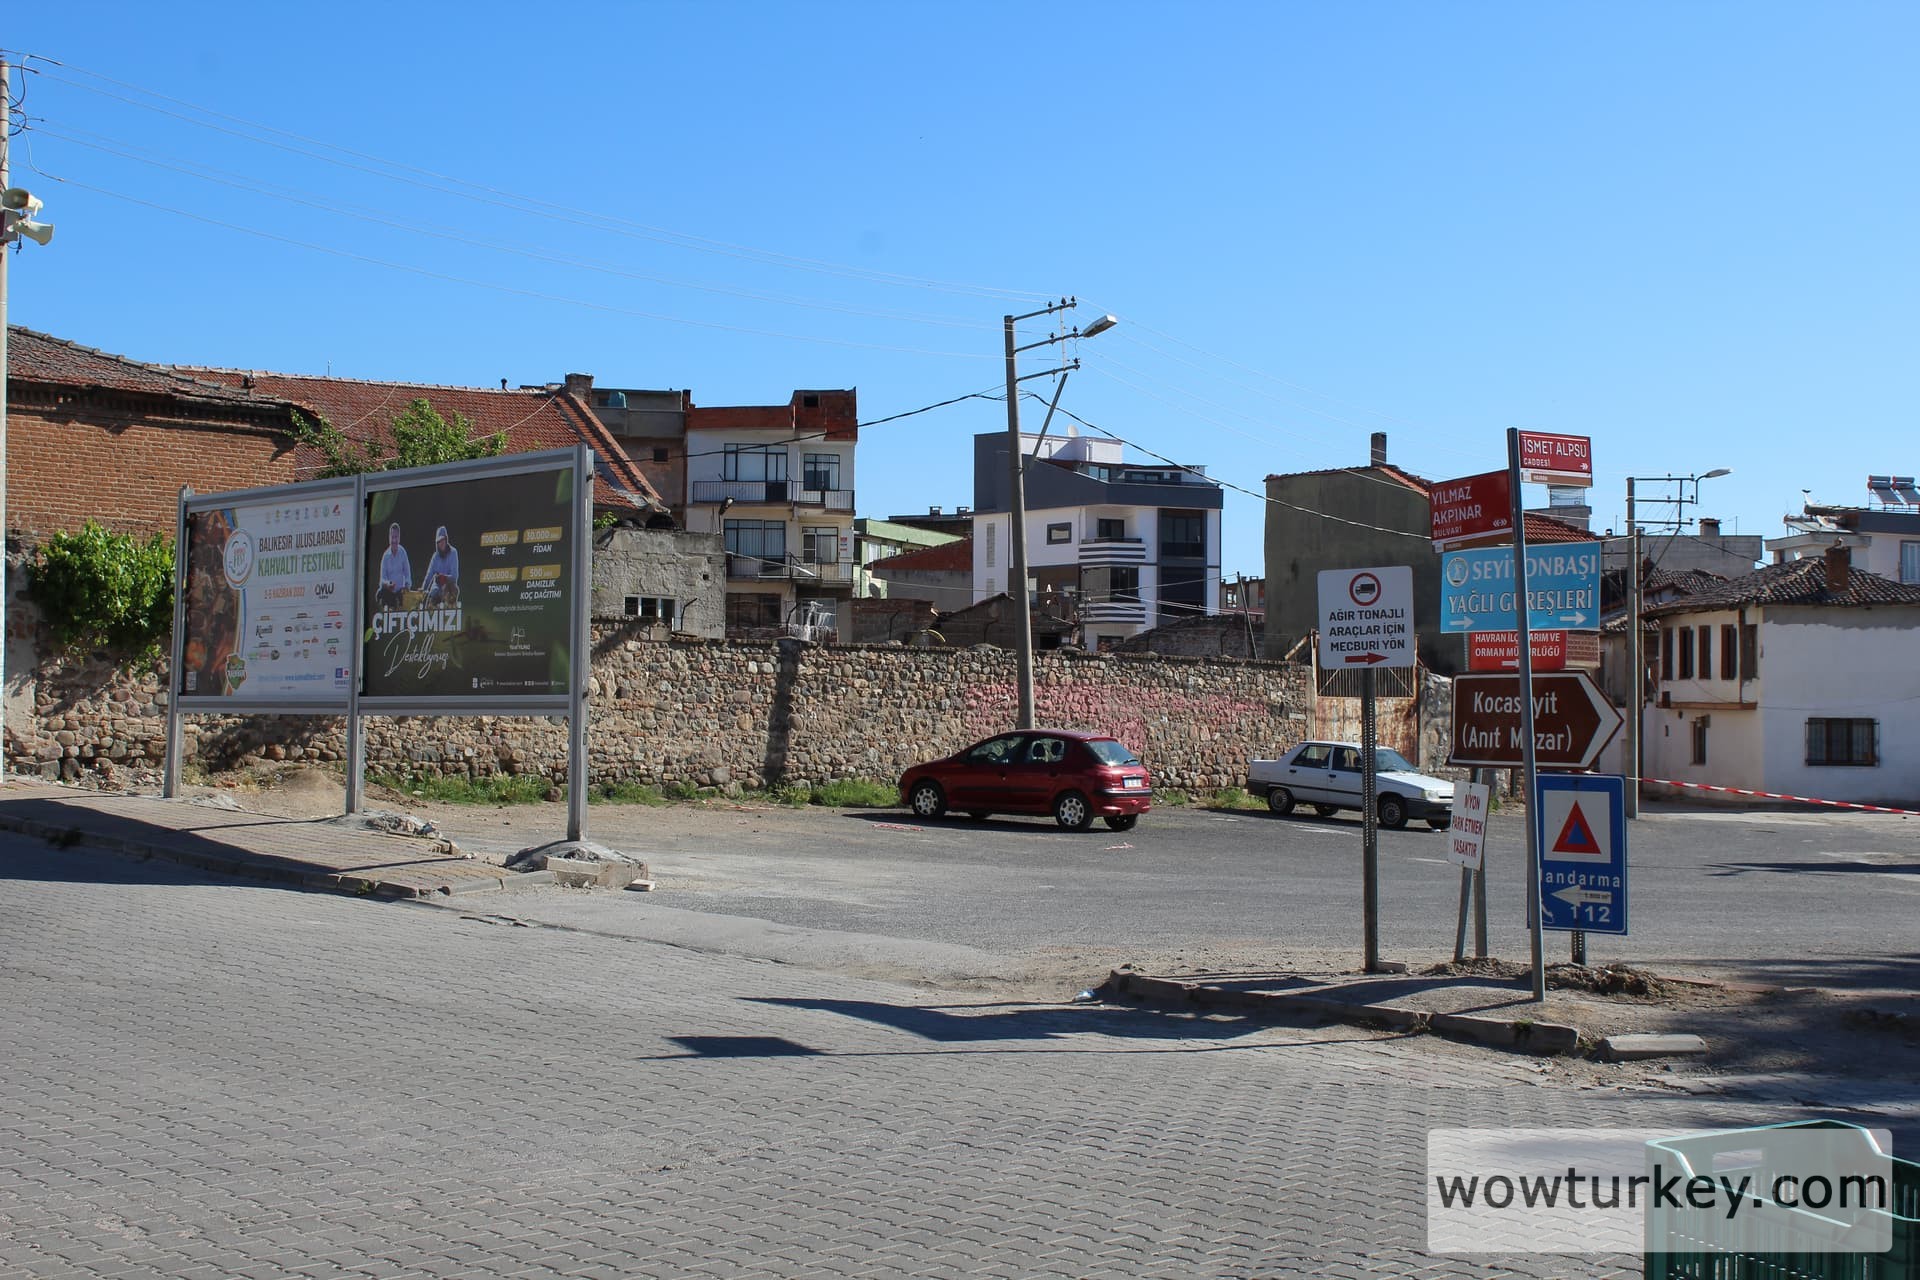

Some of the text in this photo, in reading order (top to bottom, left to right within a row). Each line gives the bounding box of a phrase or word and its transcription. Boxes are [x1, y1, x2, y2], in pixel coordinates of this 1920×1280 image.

[1523, 436, 1587, 458] İSMET ALPSU
[1431, 486, 1472, 505] YILMAZ
[1433, 504, 1482, 526] AKPINAR
[295, 528, 346, 549] ULUSLARARASI
[1433, 526, 1462, 538] BULVARI
[532, 543, 553, 553] FİDAN
[258, 555, 298, 577] KAHVALTI
[1448, 584, 1593, 616] YAĞLI GREŞLERİ
[372, 601, 462, 640] ÇİFTÇİMİZİ
[1329, 608, 1404, 621] AĞIR TONAJLI
[1329, 622, 1405, 639] ARAÇLAR İÇİN
[1475, 632, 1506, 643] HAVRAN
[1549, 632, 1560, 642] VE
[1330, 637, 1405, 652] MECBURİ YÖN
[1475, 645, 1560, 657] ORMAN MÜRLÜĞÜ
[1473, 691, 1558, 720] Kocasyit
[1510, 723, 1572, 752] Mzar)
[1452, 815, 1484, 836] PARK ETMEK
[1453, 839, 1477, 858] YASAKTIR
